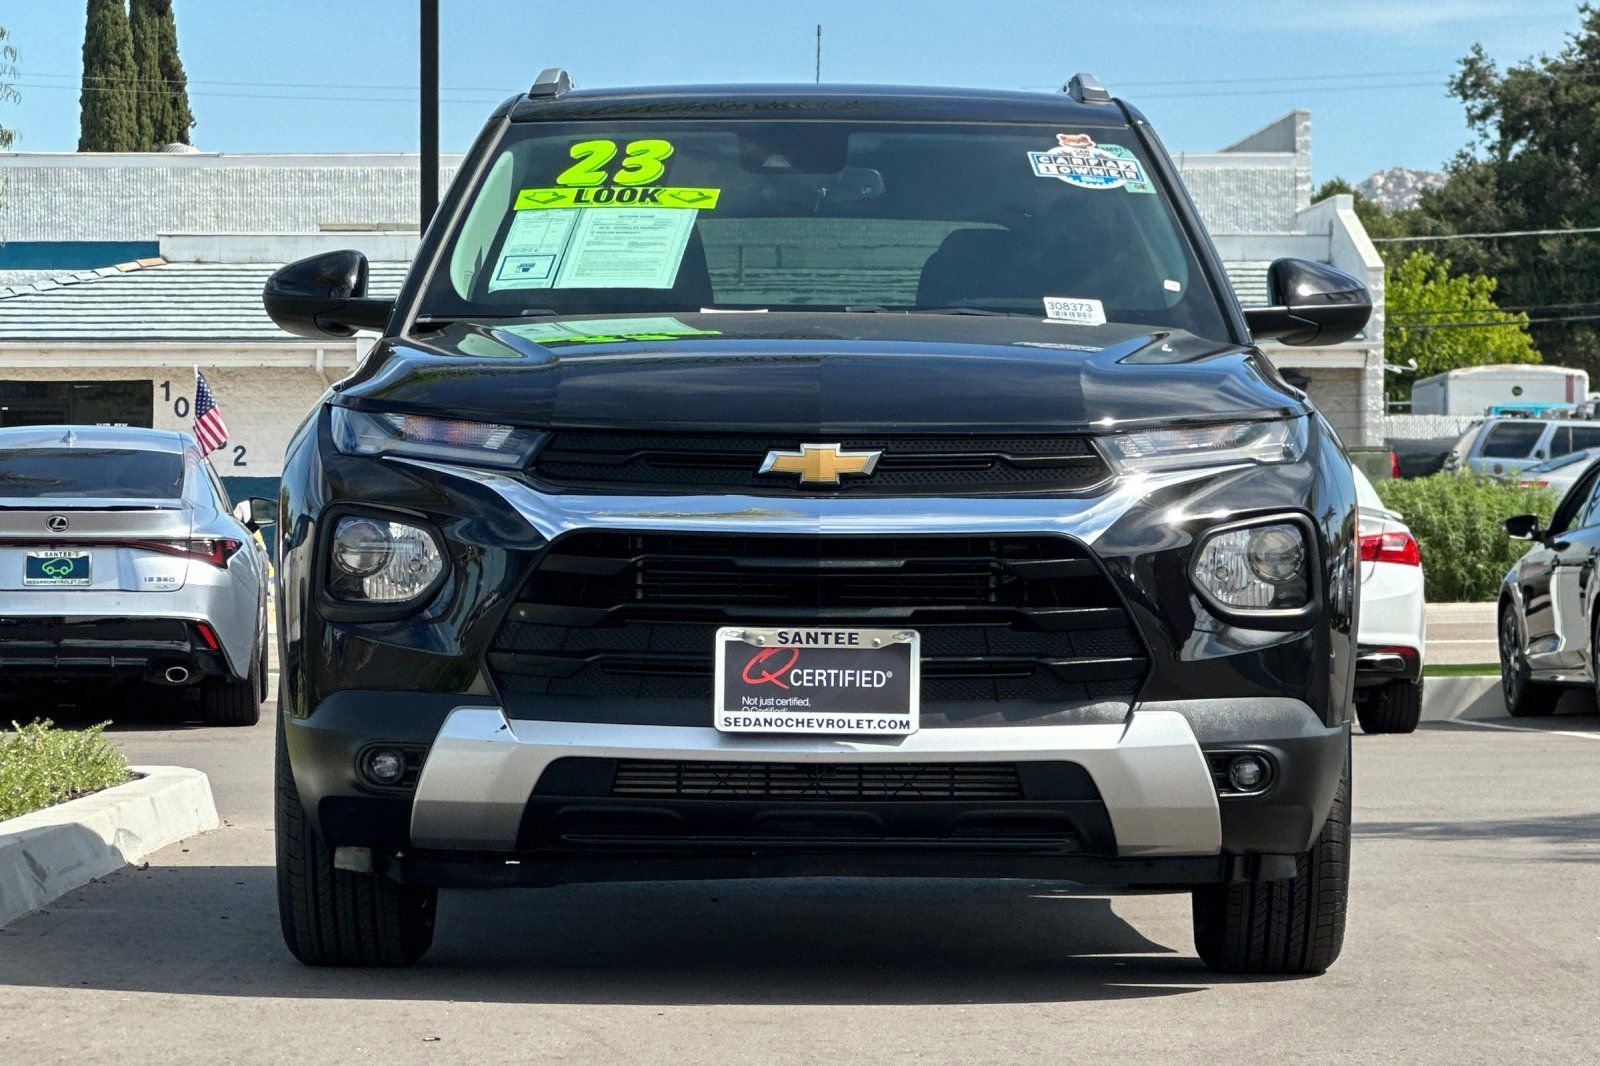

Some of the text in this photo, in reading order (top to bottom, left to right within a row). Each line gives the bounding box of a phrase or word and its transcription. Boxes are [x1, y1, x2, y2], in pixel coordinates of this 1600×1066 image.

[556, 140, 674, 186] 23
[573, 187, 663, 205] LOOK
[1047, 302, 1093, 312] 308373
[777, 631, 860, 646] SANTEE
[741, 696, 812, 707] Not just certified,
[723, 716, 911, 730] SEDANOCHEVROLET.COM
